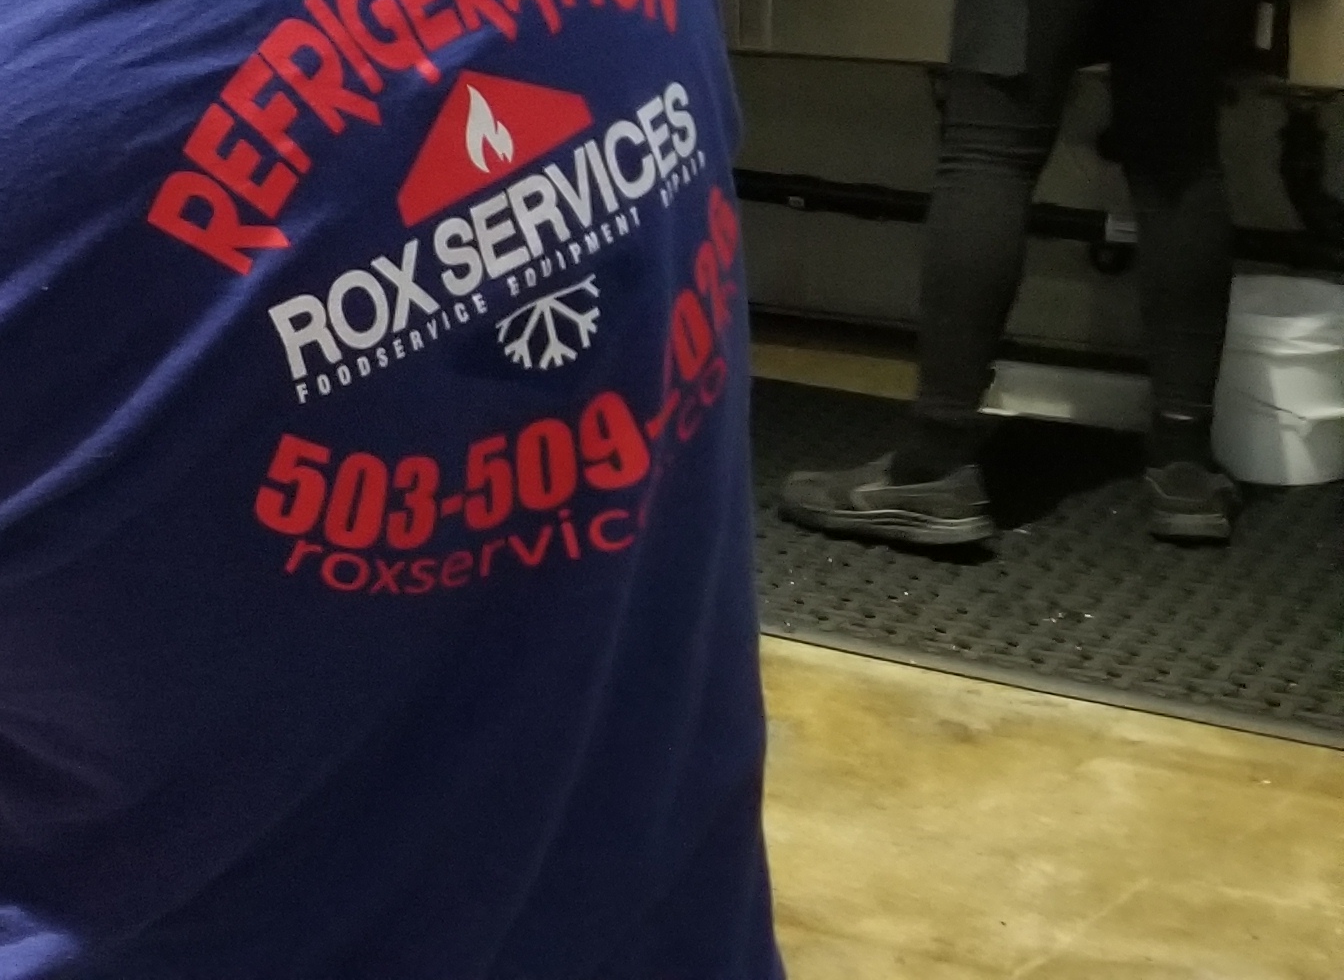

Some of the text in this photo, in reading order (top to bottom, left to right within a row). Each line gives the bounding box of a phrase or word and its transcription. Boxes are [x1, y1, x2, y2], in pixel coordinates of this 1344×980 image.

[268, 81, 698, 380] ROX SERVICES
[296, 292, 488, 404] FOODSERVICE
[507, 206, 642, 296] EQUIPMENT
